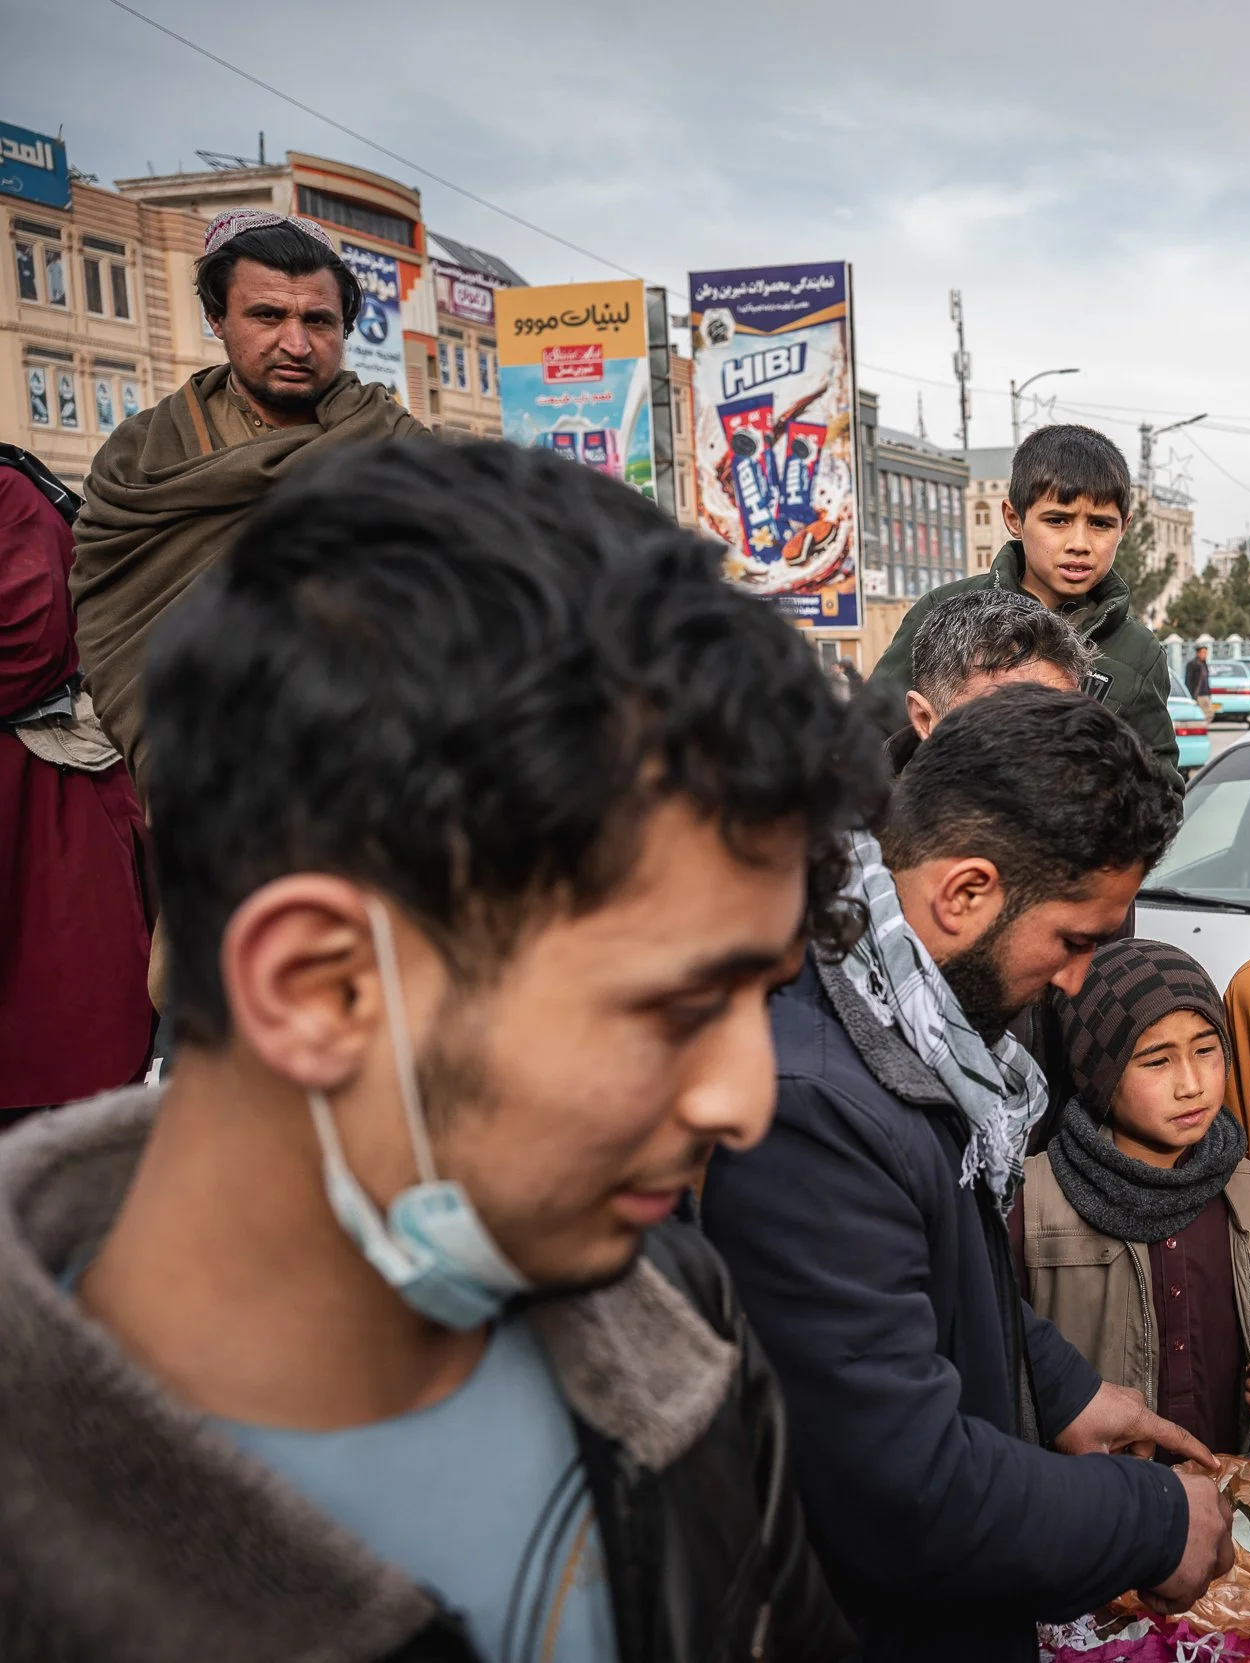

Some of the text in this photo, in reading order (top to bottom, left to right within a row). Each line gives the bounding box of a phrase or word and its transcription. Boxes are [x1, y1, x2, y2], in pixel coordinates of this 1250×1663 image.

[749, 278, 791, 297] محصولات
[791, 275, 834, 294] نمایندگی
[514, 301, 630, 336] لبنیات مووو
[723, 341, 807, 400] HIBI
[735, 458, 770, 525] HIBI
